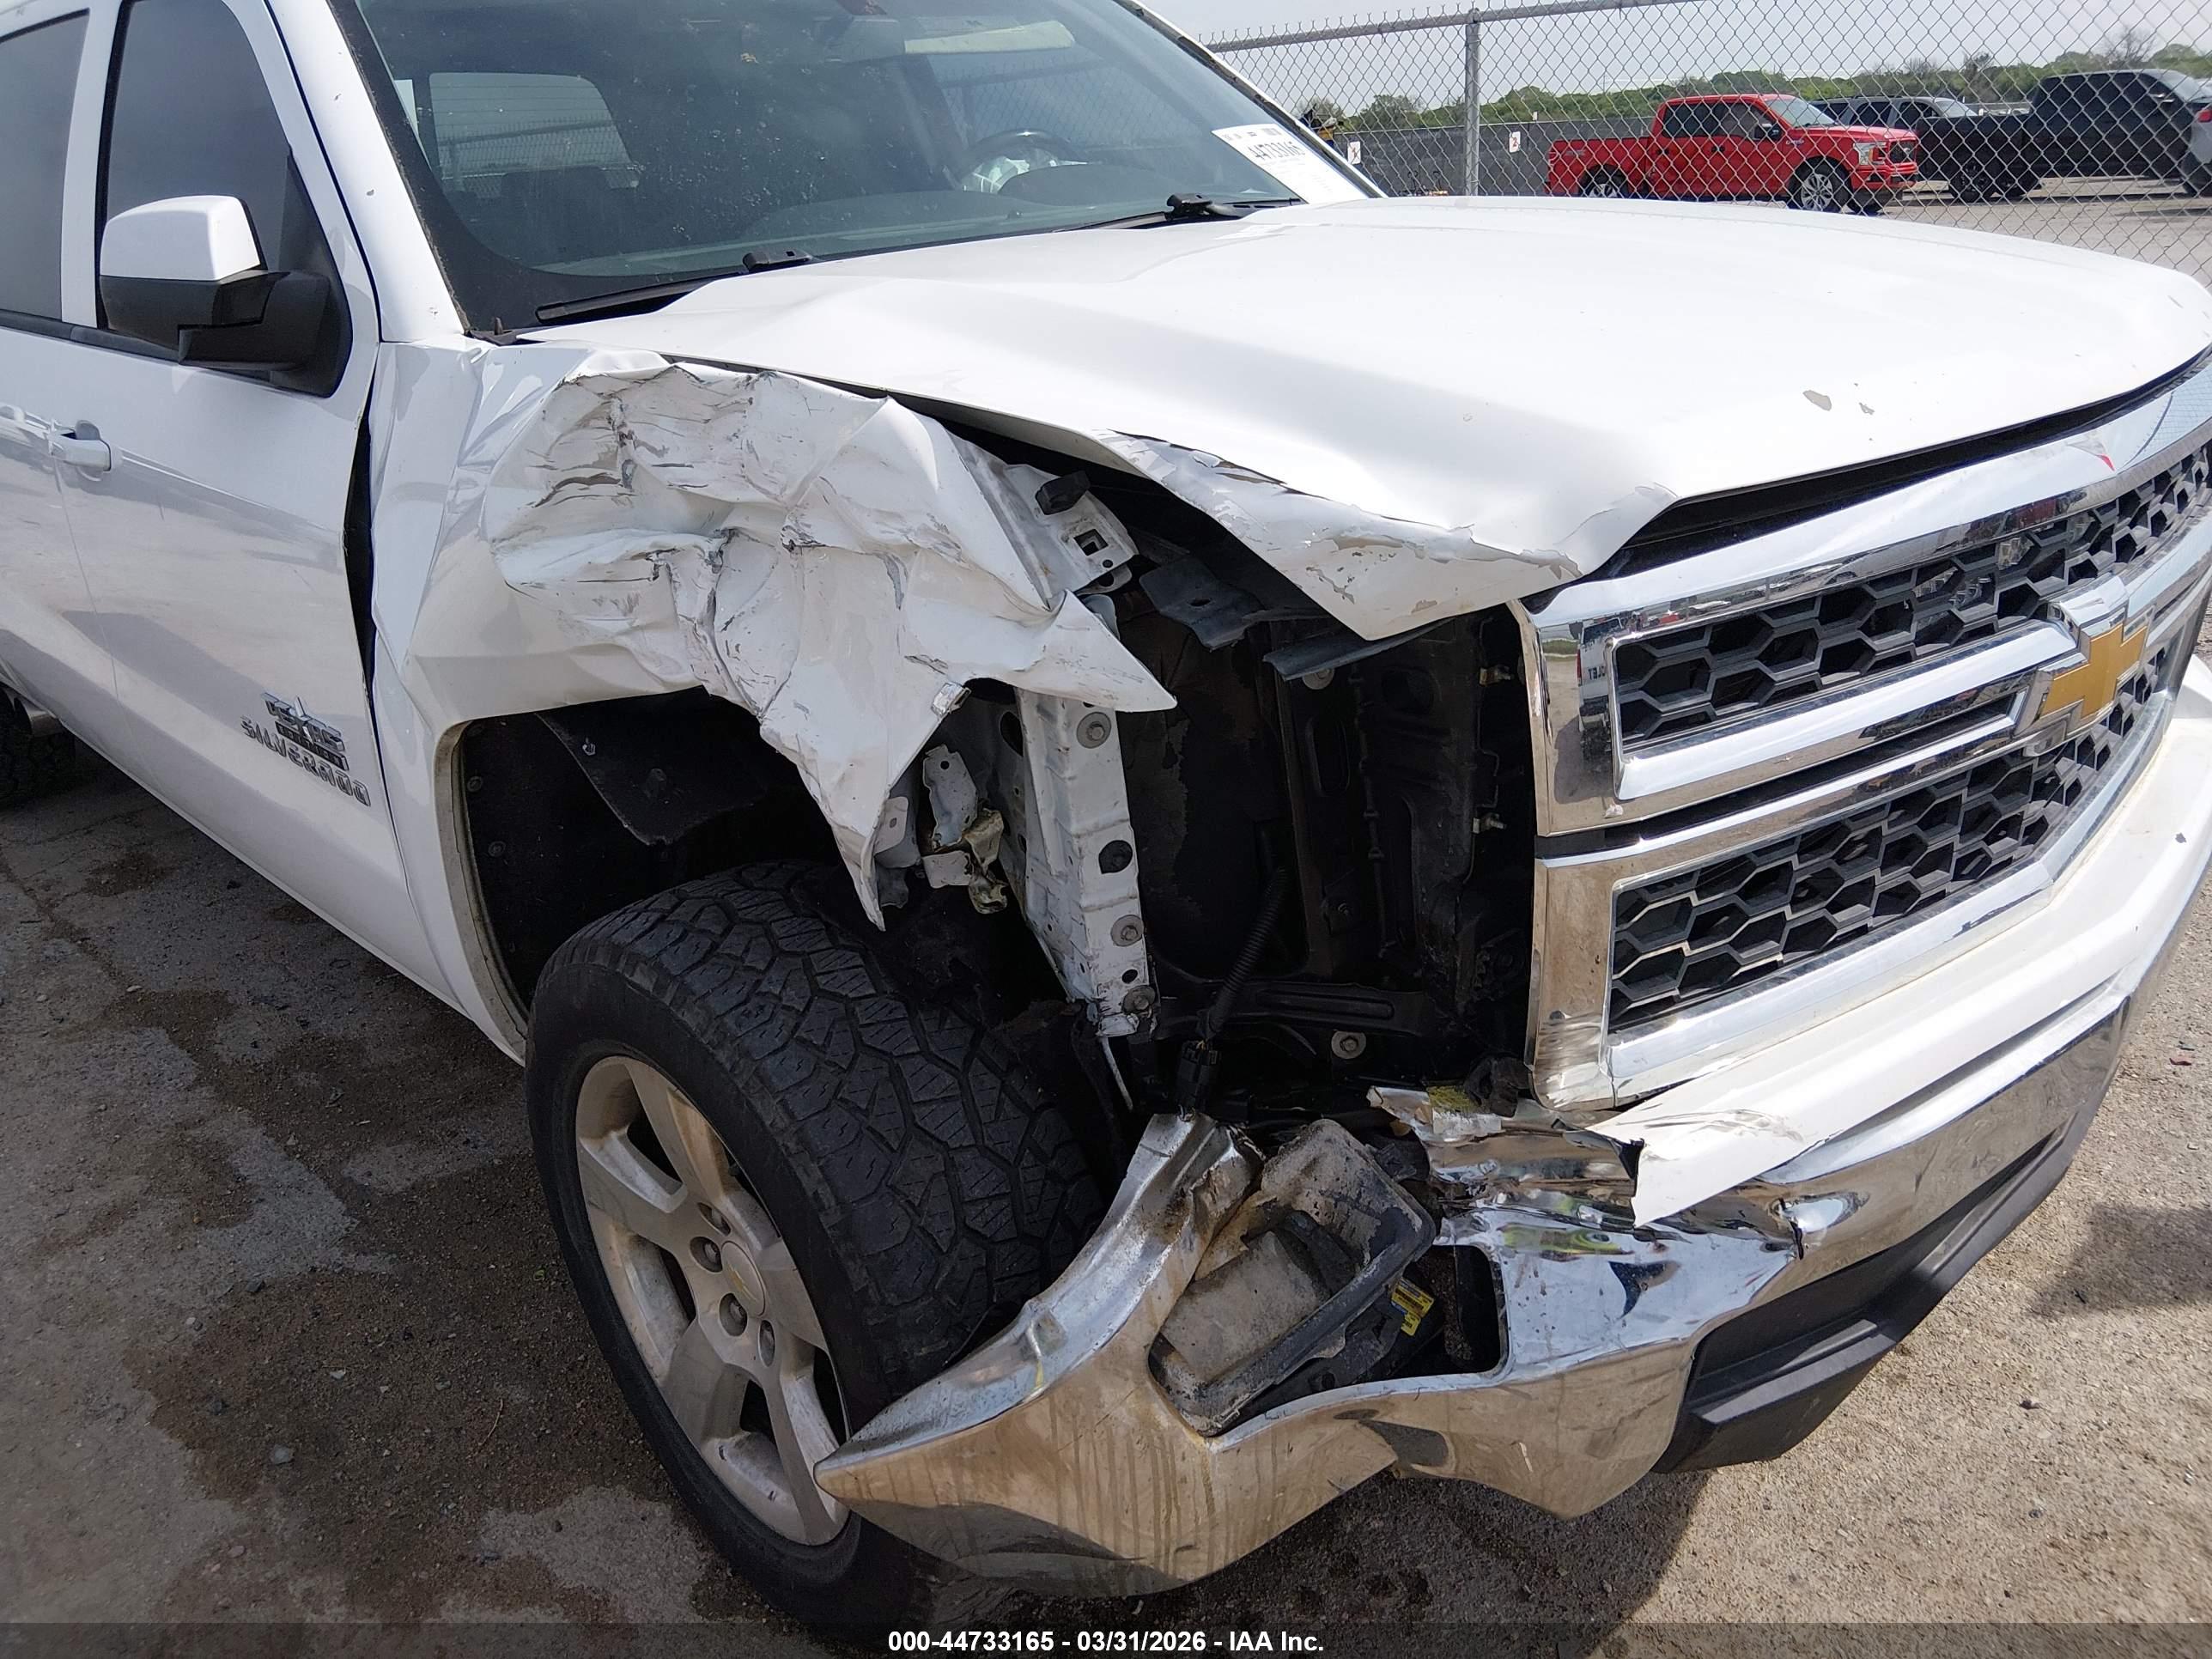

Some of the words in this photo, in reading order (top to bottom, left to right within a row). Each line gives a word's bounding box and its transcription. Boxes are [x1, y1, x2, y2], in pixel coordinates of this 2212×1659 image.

[260, 692, 345, 752] TEXAS
[275, 722, 346, 769] EDITION
[240, 714, 372, 807] SILVERADO
